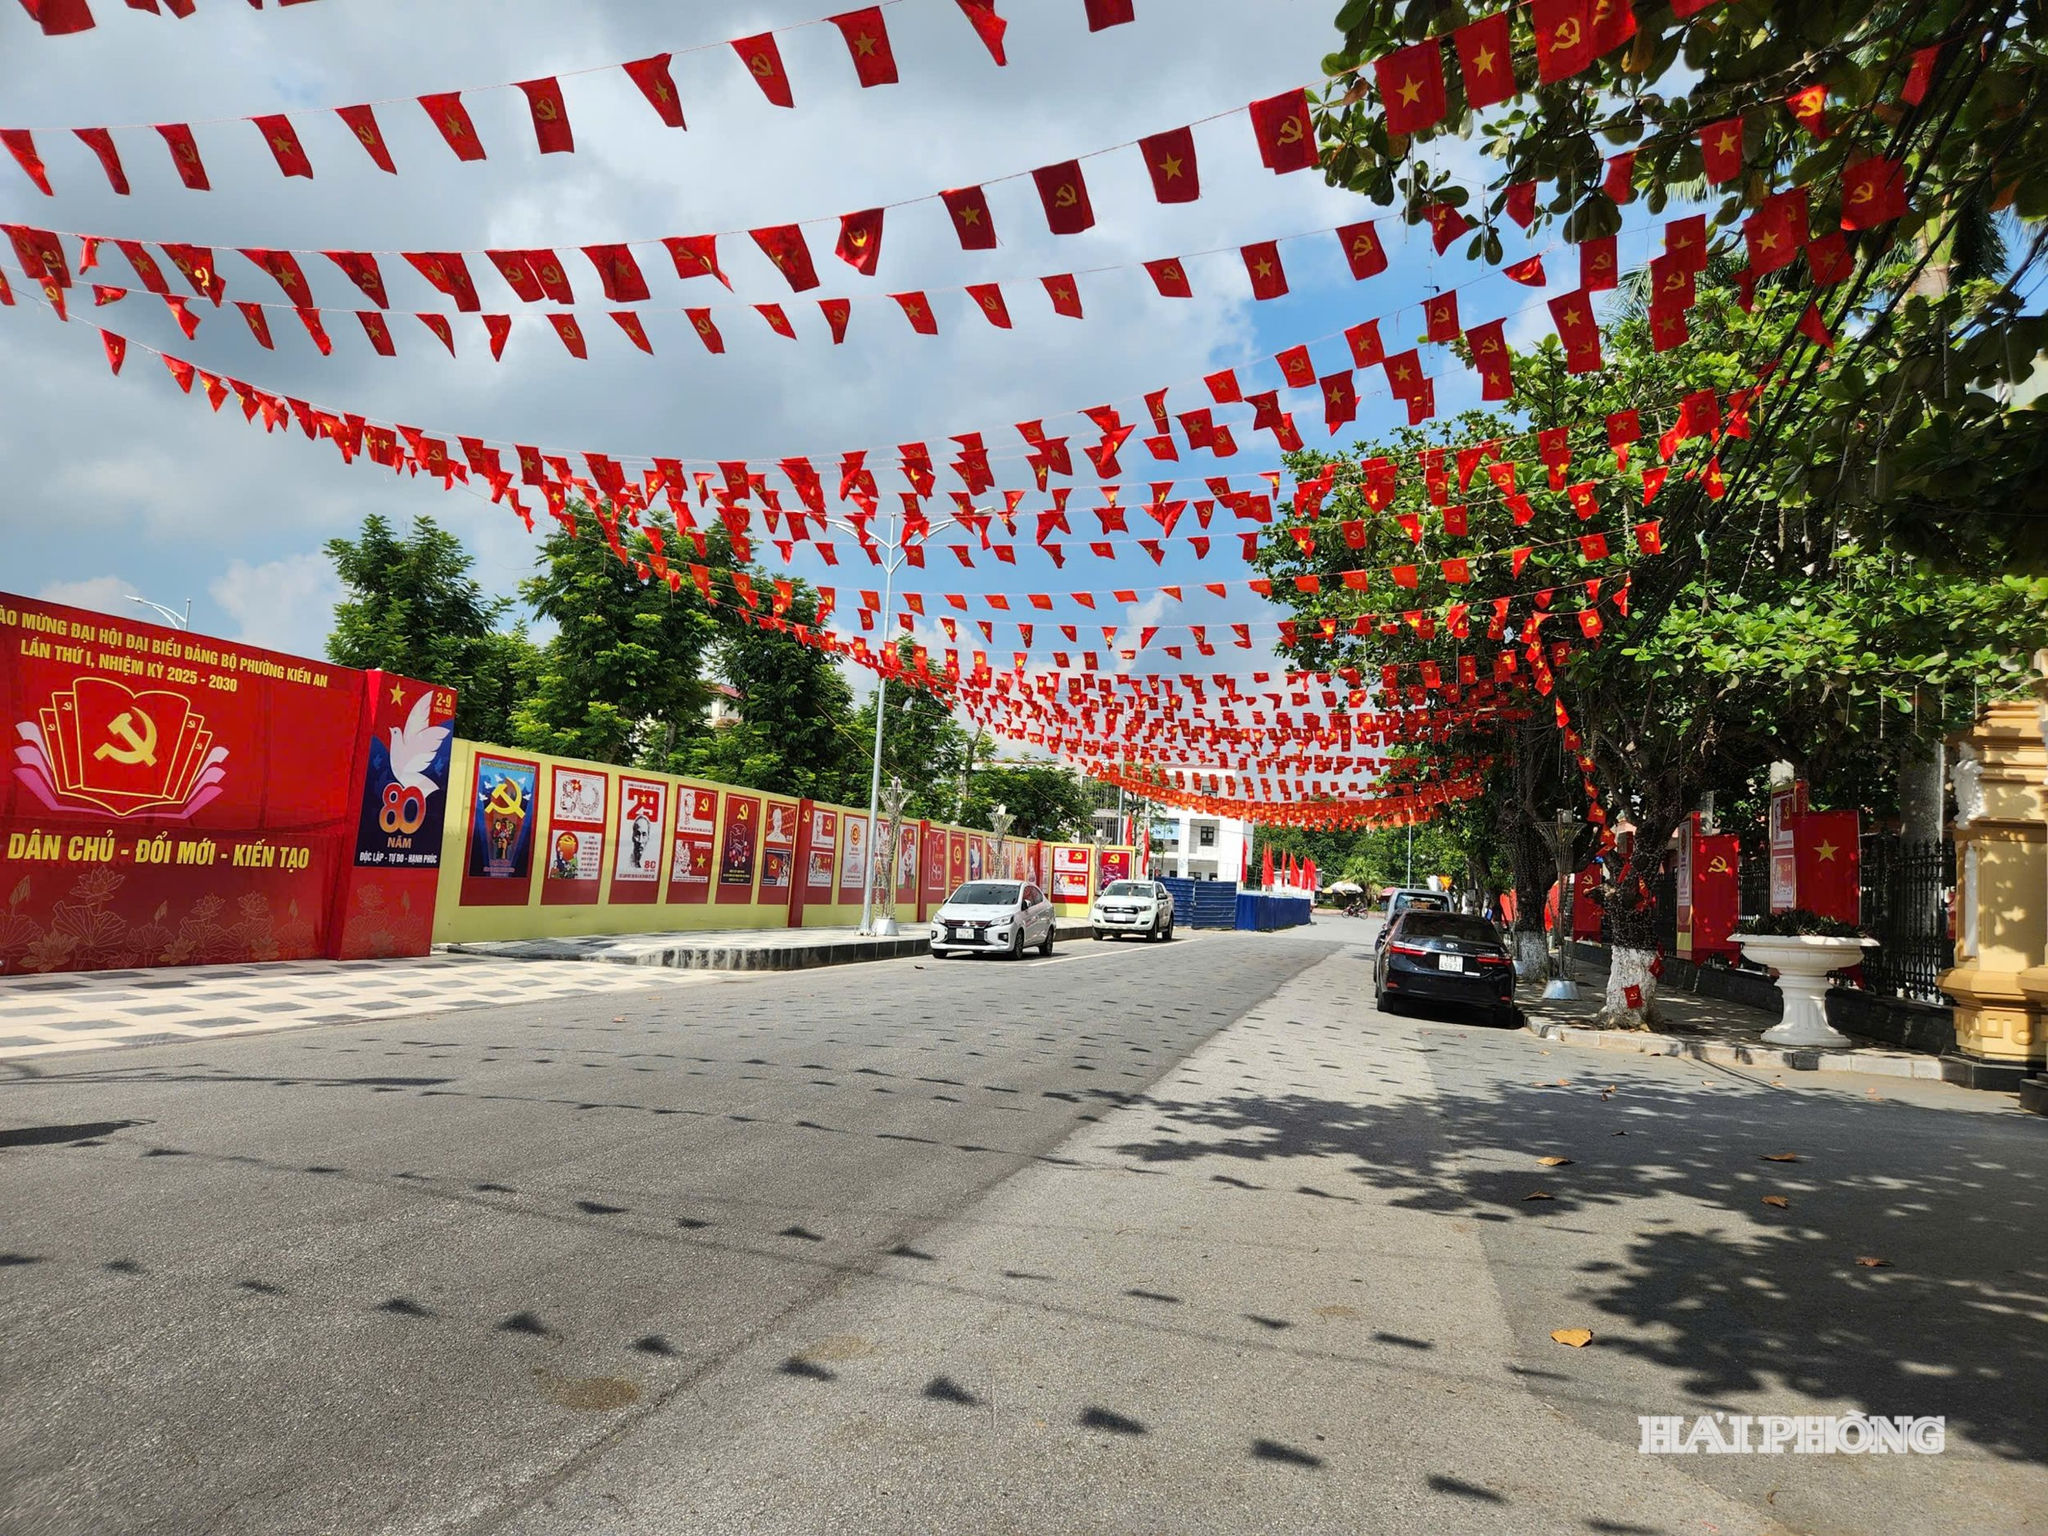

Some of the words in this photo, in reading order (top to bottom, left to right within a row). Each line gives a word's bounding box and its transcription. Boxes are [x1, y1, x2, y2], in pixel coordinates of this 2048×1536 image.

[20, 636, 50, 659] LẦN
[55, 645, 84, 664] THỨ
[86, 651, 95, 669] I,
[99, 653, 144, 676] NHIỆM
[147, 661, 164, 679] KỲ
[167, 666, 198, 685] 2025
[208, 674, 238, 692] 2030
[22, 612, 67, 636] MỪNG
[71, 622, 95, 643] ĐẠI
[99, 627, 122, 648] HỘI
[126, 634, 149, 653] ĐẠI
[152, 637, 181, 658] BIỂU
[185, 644, 218, 666] ĐẢNG
[221, 652, 237, 672] BỘ
[240, 657, 284, 679] PHƯỜNG
[287, 666, 312, 684] KIẾN
[313, 673, 328, 688] AN
[379, 782, 427, 834] 80
[7, 828, 62, 861] DÂN
[67, 829, 115, 862] CHỦ
[135, 831, 172, 865] ĐỔI
[176, 837, 217, 866] MỚI
[233, 838, 275, 868] KIẾN
[279, 847, 310, 873] TẠO
